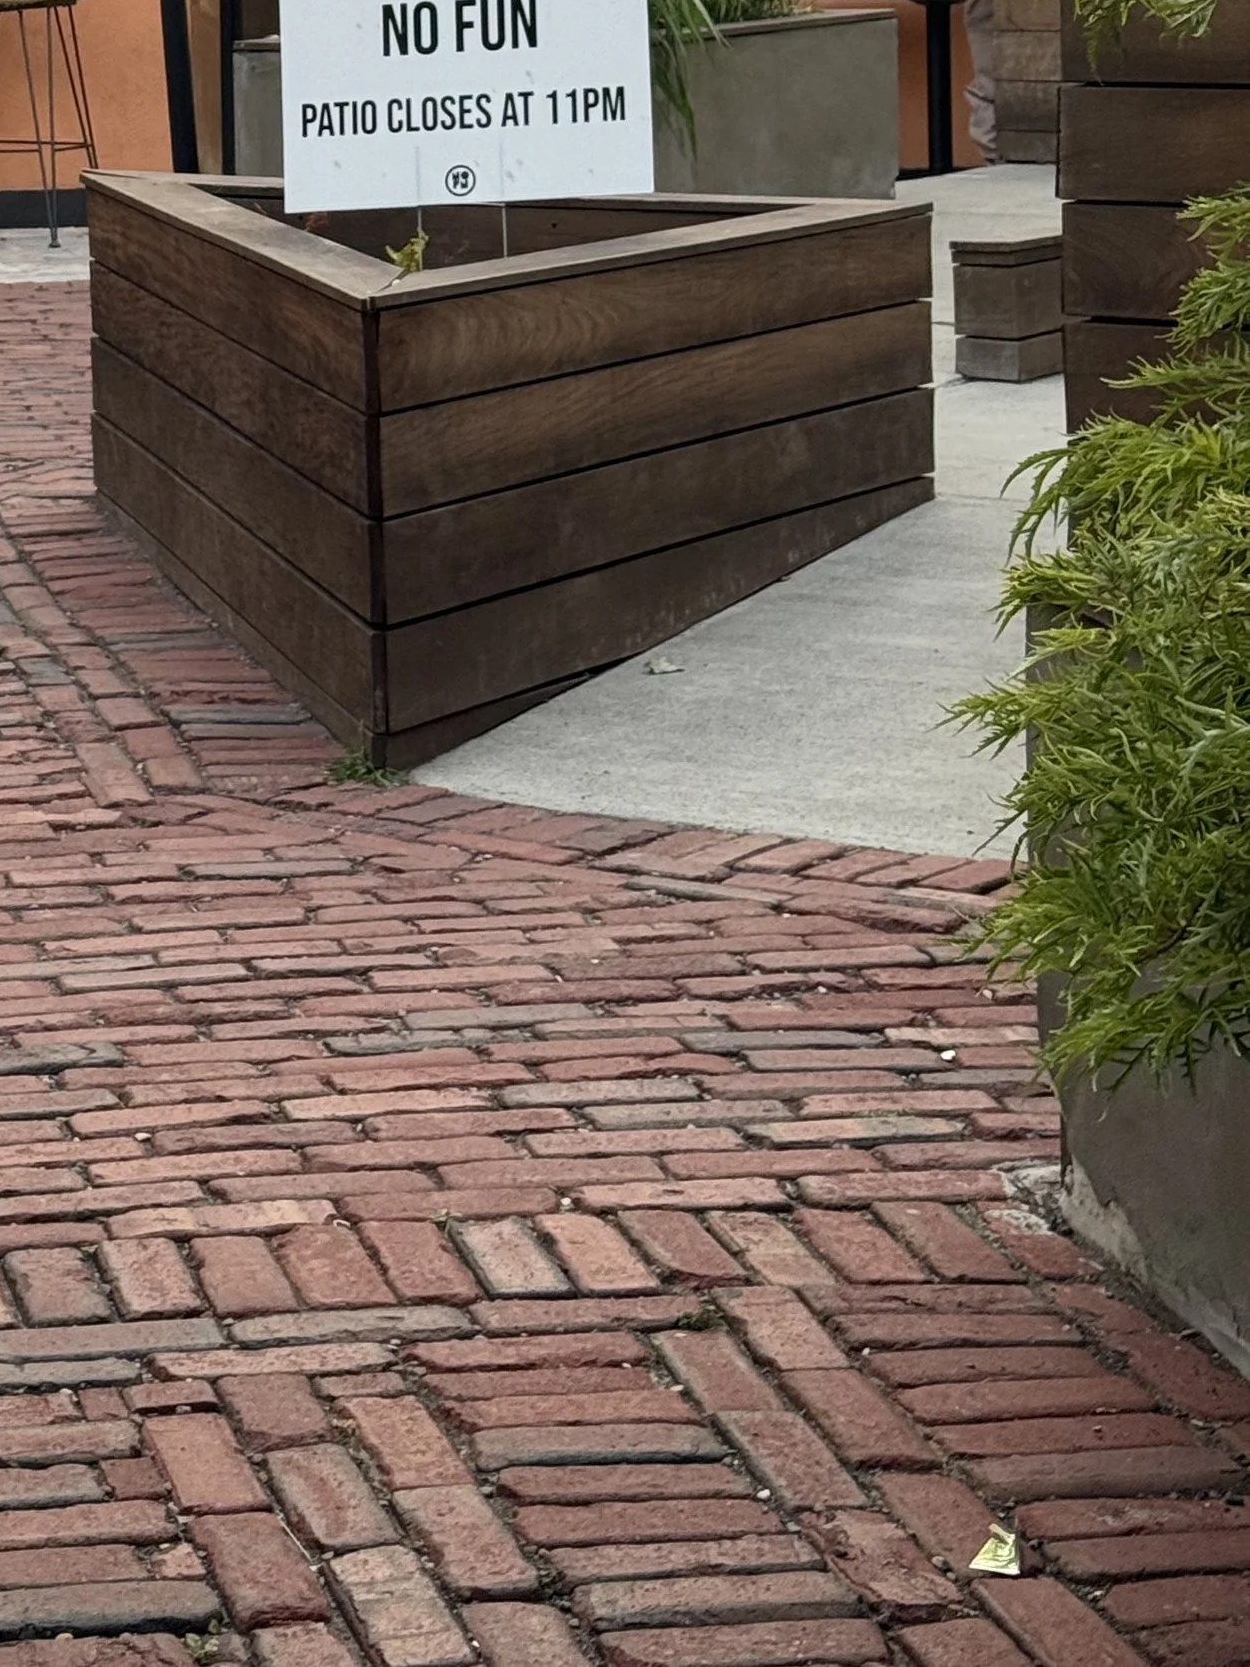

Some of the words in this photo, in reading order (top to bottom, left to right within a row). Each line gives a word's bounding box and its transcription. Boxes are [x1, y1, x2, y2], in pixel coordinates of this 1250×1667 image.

[382, 1, 438, 57] NO
[302, 100, 377, 137] PATIO
[387, 93, 492, 133] CLOSES
[501, 91, 535, 127] AT
[546, 86, 626, 125] 11PM
